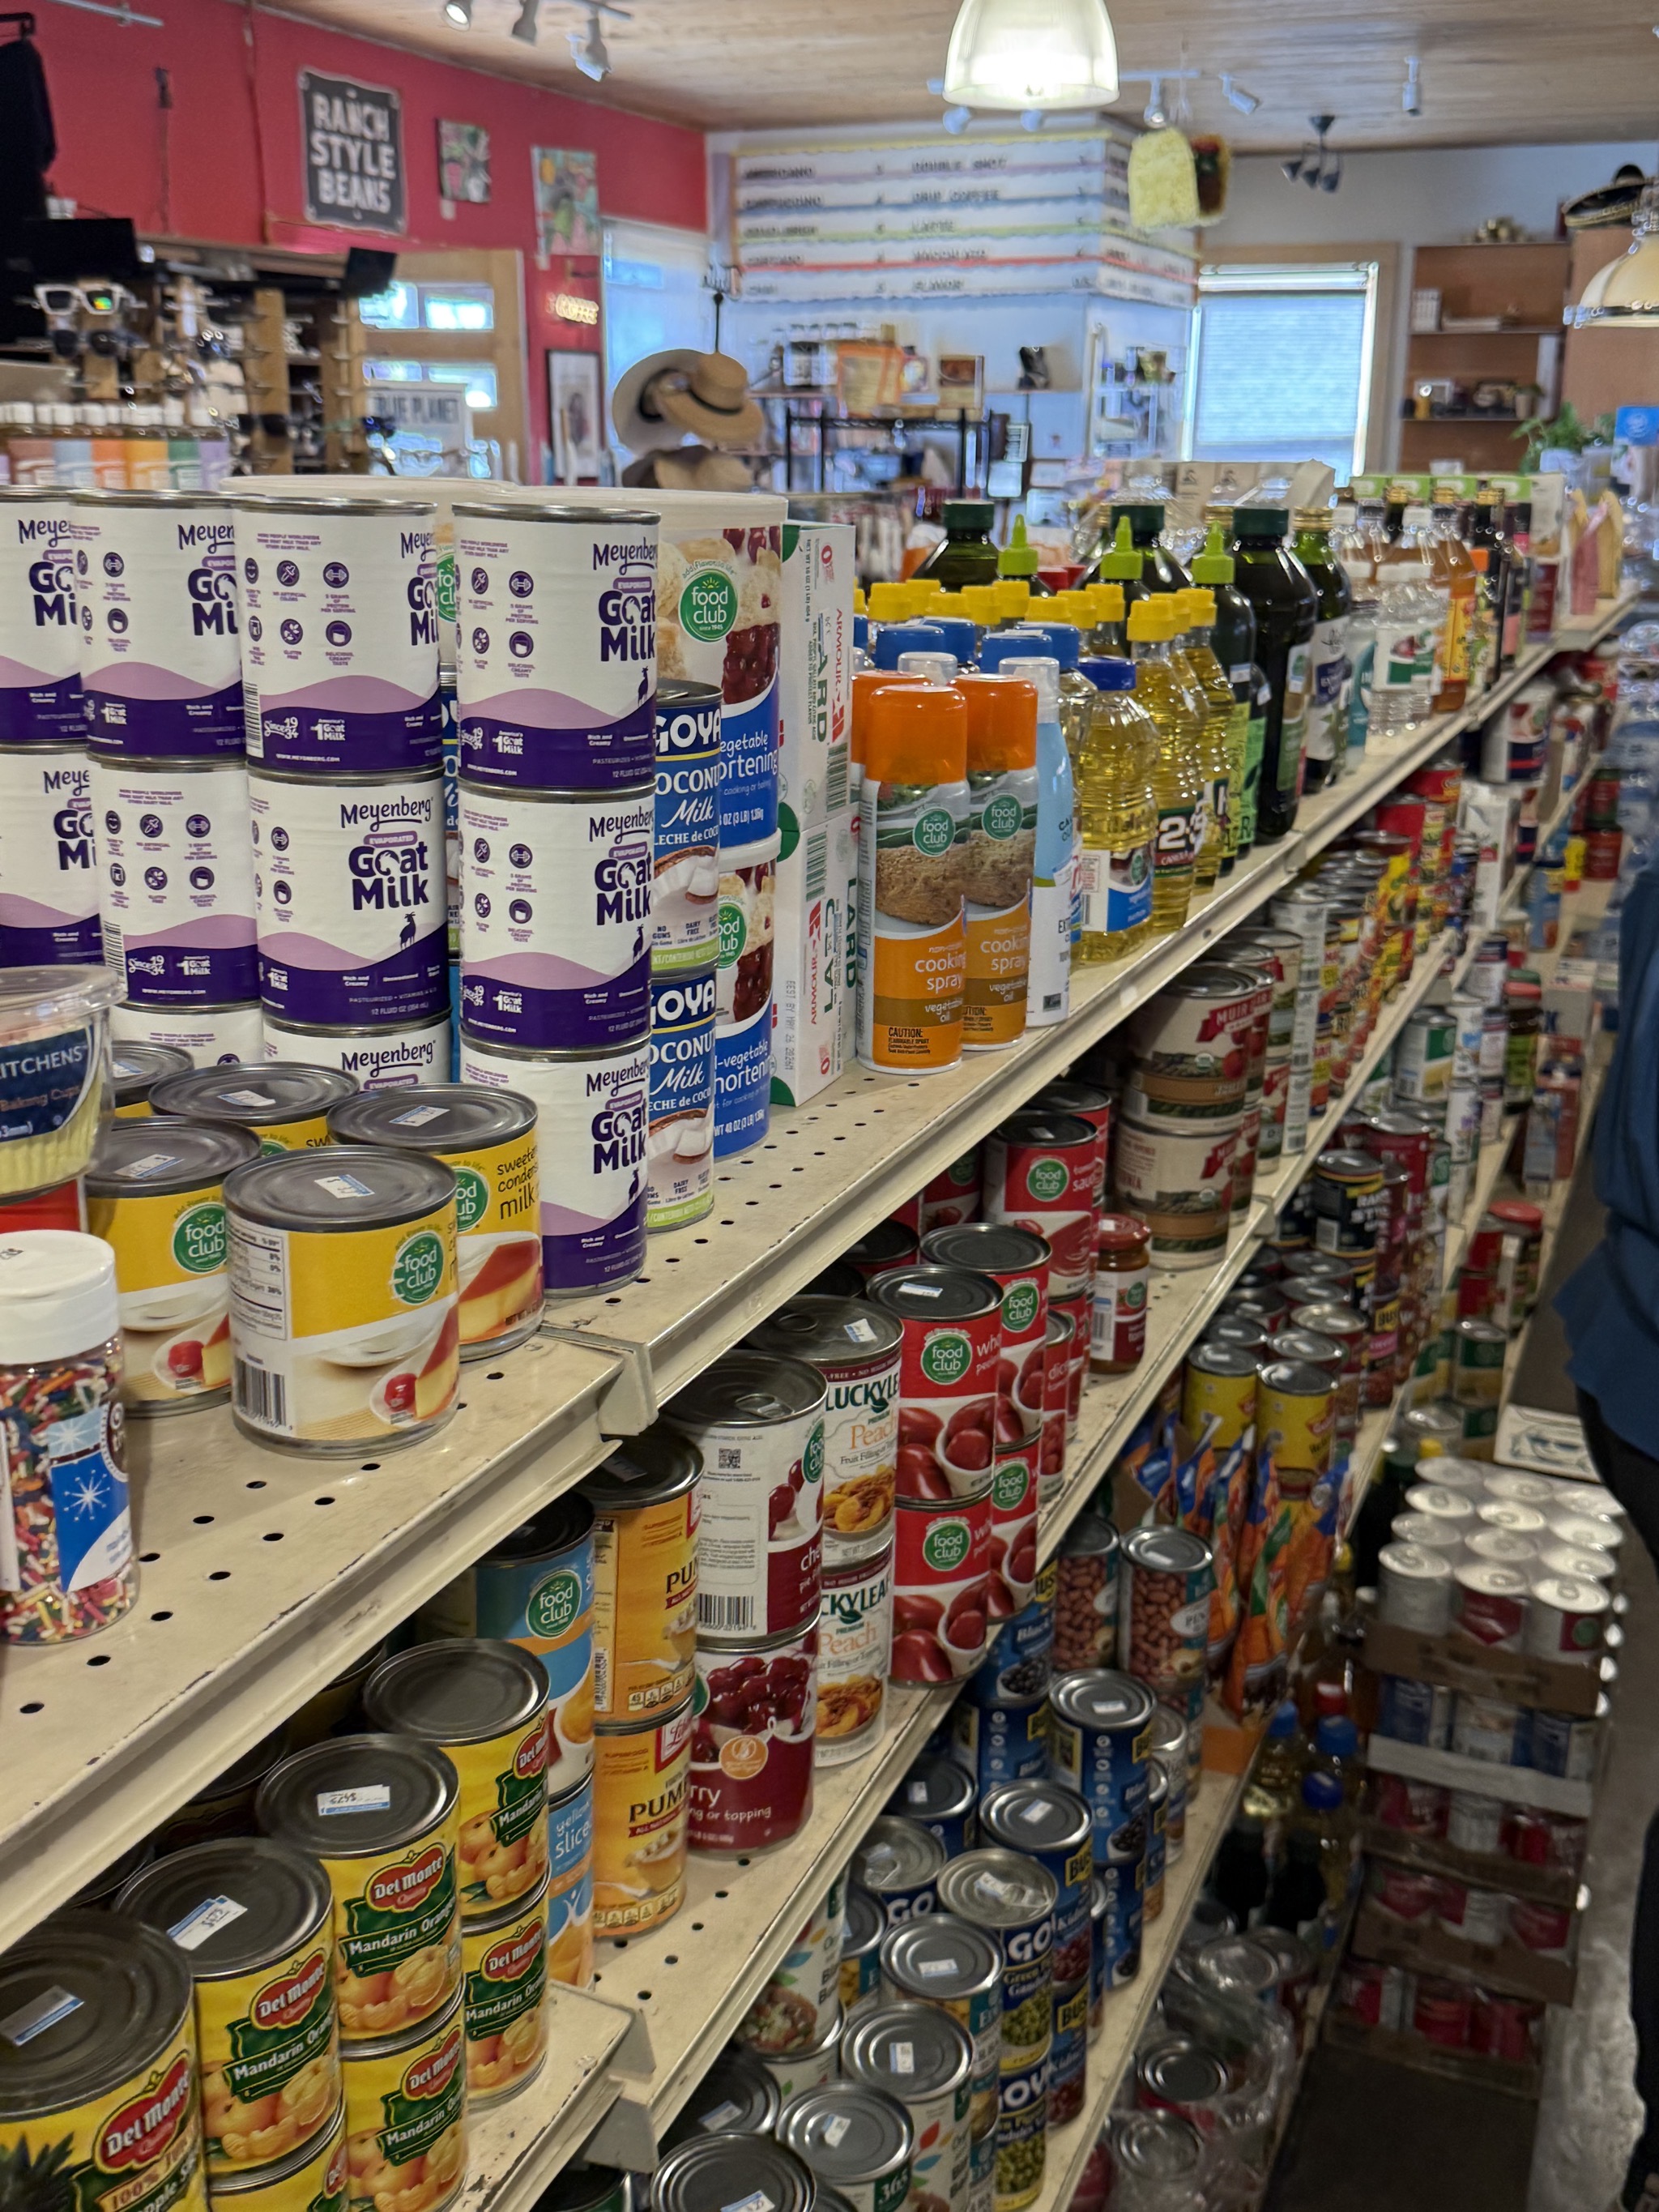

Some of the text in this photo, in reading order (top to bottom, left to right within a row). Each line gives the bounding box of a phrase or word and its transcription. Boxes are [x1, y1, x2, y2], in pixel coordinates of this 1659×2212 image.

[313, 94, 389, 142] RANCH
[309, 135, 395, 180] STYLE
[319, 179, 390, 216] BEANS
[692, 586, 728, 606] food
[599, 590, 656, 626] Goat
[693, 604, 728, 625] club
[600, 625, 656, 662] Milk
[834, 609, 845, 685] ARMOUR
[284, 716, 298, 728] 19
[324, 724, 346, 732] Goat
[655, 709, 722, 753] GOYA
[324, 732, 346, 741] Milk
[503, 745, 523, 755] Milk
[340, 796, 433, 831] Meyenberg
[661, 795, 714, 829] Milk
[723, 813, 732, 825] OZ
[992, 805, 1017, 820] food
[922, 818, 949, 835] food
[992, 816, 1016, 831] club
[369, 834, 414, 845] EVAPORATED
[692, 830, 702, 841] de
[923, 831, 949, 845] club
[348, 842, 428, 878] Goat
[352, 874, 429, 911] Milk
[652, 932, 671, 940] GUMS
[846, 878, 856, 989] LARD
[190, 967, 211, 976] Milk
[991, 956, 1026, 975] spray
[785, 980, 796, 999] BEST
[809, 954, 818, 1025] ARMOUR
[927, 974, 962, 994] spray
[349, 995, 393, 1003] PASTEURIZED
[1004, 991, 1013, 1002] oil
[503, 1004, 522, 1013] Milk
[785, 1003, 796, 1013] BY
[940, 1013, 950, 1023] oil
[1215, 1002, 1248, 1026] MUIR
[785, 1016, 796, 1030] MAY
[888, 1027, 923, 1038] CAUTION:
[785, 1033, 796, 1044] 26
[341, 1041, 434, 1078] Meyenberg
[650, 1061, 705, 1095] Milk
[679, 1095, 691, 1108] de
[593, 1137, 646, 1174] Milk
[1035, 1168, 1063, 1181] food
[1036, 1179, 1061, 1191] club
[500, 1186, 535, 1219] milk
[185, 1217, 225, 1241] food
[188, 1236, 224, 1258] club
[403, 1248, 437, 1274] food
[406, 1266, 437, 1290] club
[1009, 1294, 1034, 1312] food
[1009, 1307, 1034, 1322] club
[932, 1344, 964, 1361] food
[932, 1356, 962, 1373] club
[840, 1455, 859, 1465] Fruit
[998, 1471, 1024, 1490] food
[998, 1483, 1023, 1500] club
[933, 1530, 964, 1548] food
[934, 1543, 962, 1559] club
[539, 1586, 574, 1610] food
[540, 1602, 573, 1625] club
[836, 1621, 865, 1636] PREMIUM
[817, 1621, 878, 1657] Peach
[518, 1748, 535, 1768] Del
[707, 1806, 772, 1824] or topping
[374, 1855, 443, 1900] Del Monte
[349, 1927, 418, 1956] Mandarin
[488, 1930, 543, 1972] Del Monte
[258, 1962, 325, 2019] Del Monte
[467, 1992, 523, 2022] Mandarin
[234, 2042, 305, 2082] Mandarin
[410, 2041, 462, 2090] Del Monte
[105, 2070, 189, 2159] Del Monte
[386, 2108, 446, 2147] Mandarin
[111, 2165, 159, 2210] 100%
